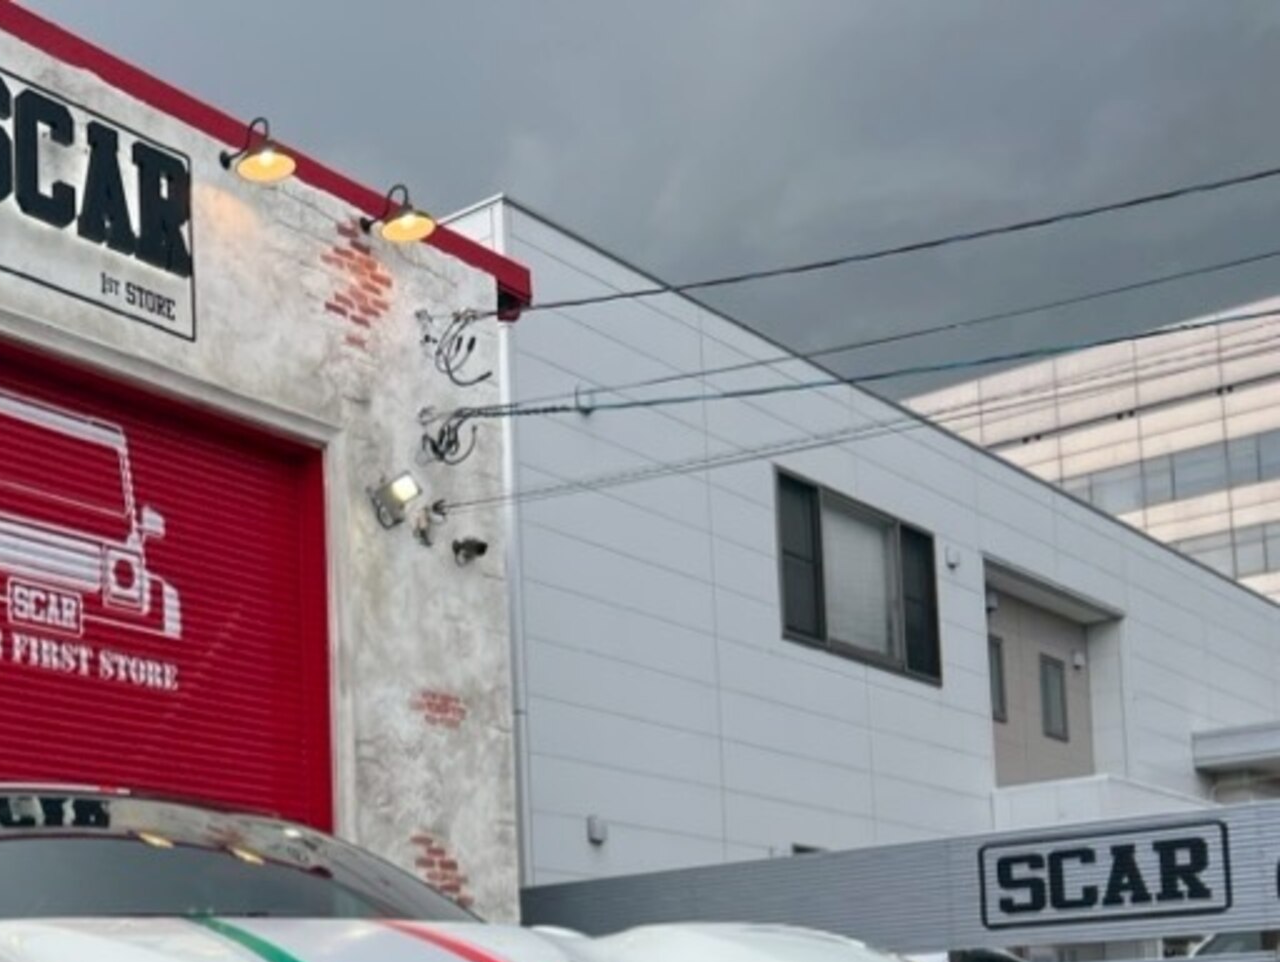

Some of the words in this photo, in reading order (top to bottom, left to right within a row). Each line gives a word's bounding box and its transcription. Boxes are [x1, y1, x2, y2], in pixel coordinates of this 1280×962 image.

[125, 281, 176, 321] STORE
[13, 585, 78, 628] SCAR
[11, 632, 93, 676] FIRST
[99, 650, 179, 691] STORE
[997, 837, 1212, 914] SCAR
